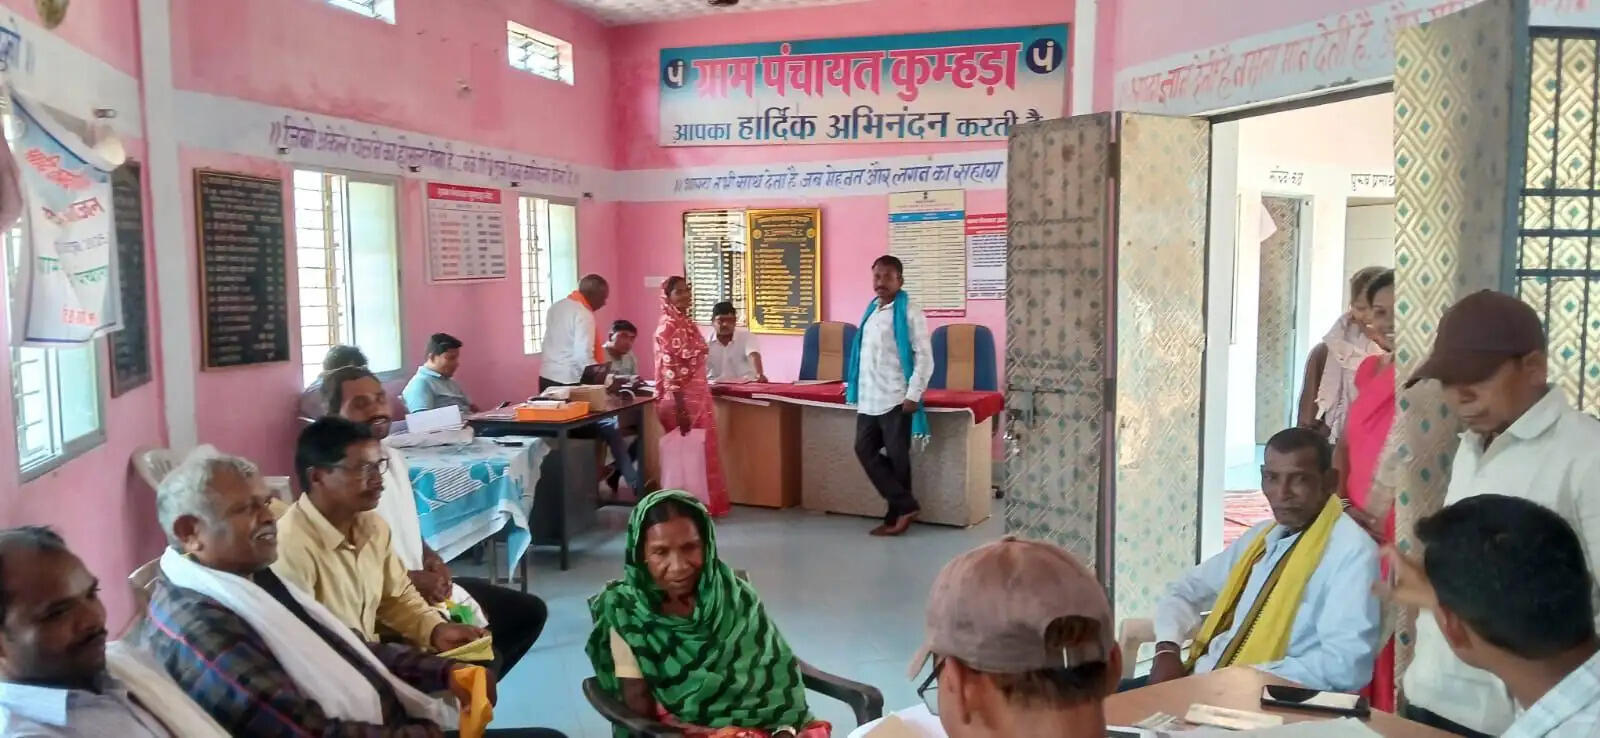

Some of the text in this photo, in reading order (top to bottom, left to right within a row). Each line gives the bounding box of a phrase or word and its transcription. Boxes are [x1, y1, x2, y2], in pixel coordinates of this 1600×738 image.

[691, 42, 1023, 102] ग्राम पंचायत कुम्हड़ा
[673, 122, 732, 144] आपका
[737, 106, 818, 141] हार्दिक
[826, 104, 950, 141] अभिनंदन
[932, 164, 954, 182] का
